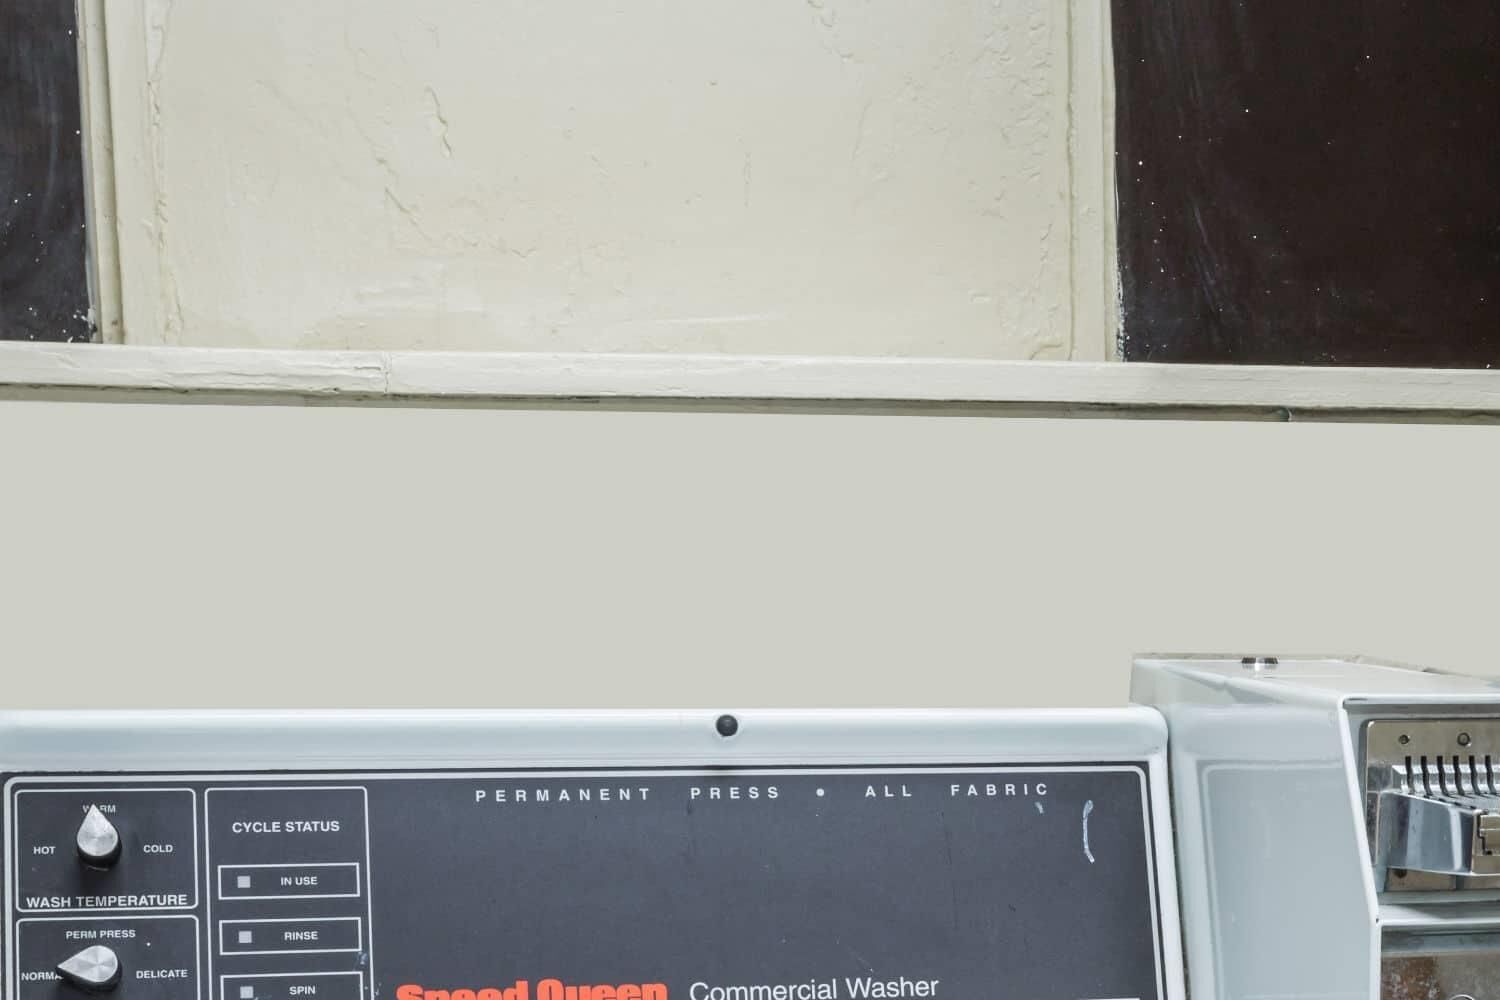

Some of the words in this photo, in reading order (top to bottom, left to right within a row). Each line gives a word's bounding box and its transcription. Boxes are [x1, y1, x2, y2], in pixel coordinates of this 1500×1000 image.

[475, 788, 649, 802] PERMANENT
[690, 786, 779, 800] PRESS
[865, 785, 912, 797] ALL
[951, 784, 1047, 796] FABRIC
[82, 804, 117, 814] WRM
[232, 822, 281, 834] CYCLE
[285, 820, 340, 832] STATUS
[33, 846, 56, 855] HOT
[143, 844, 173, 854] COLD
[280, 877, 293, 886] IN
[295, 876, 318, 886] USE
[26, 896, 72, 909] WASH
[76, 894, 188, 908] TEMPERATURE
[66, 930, 97, 940] PERM
[100, 929, 136, 939] PRESS
[284, 931, 318, 941] RINSE
[21, 971, 64, 981] NORMA
[136, 969, 188, 979] DELICATE
[289, 986, 316, 995] SPIN
[846, 976, 939, 999] Washer
